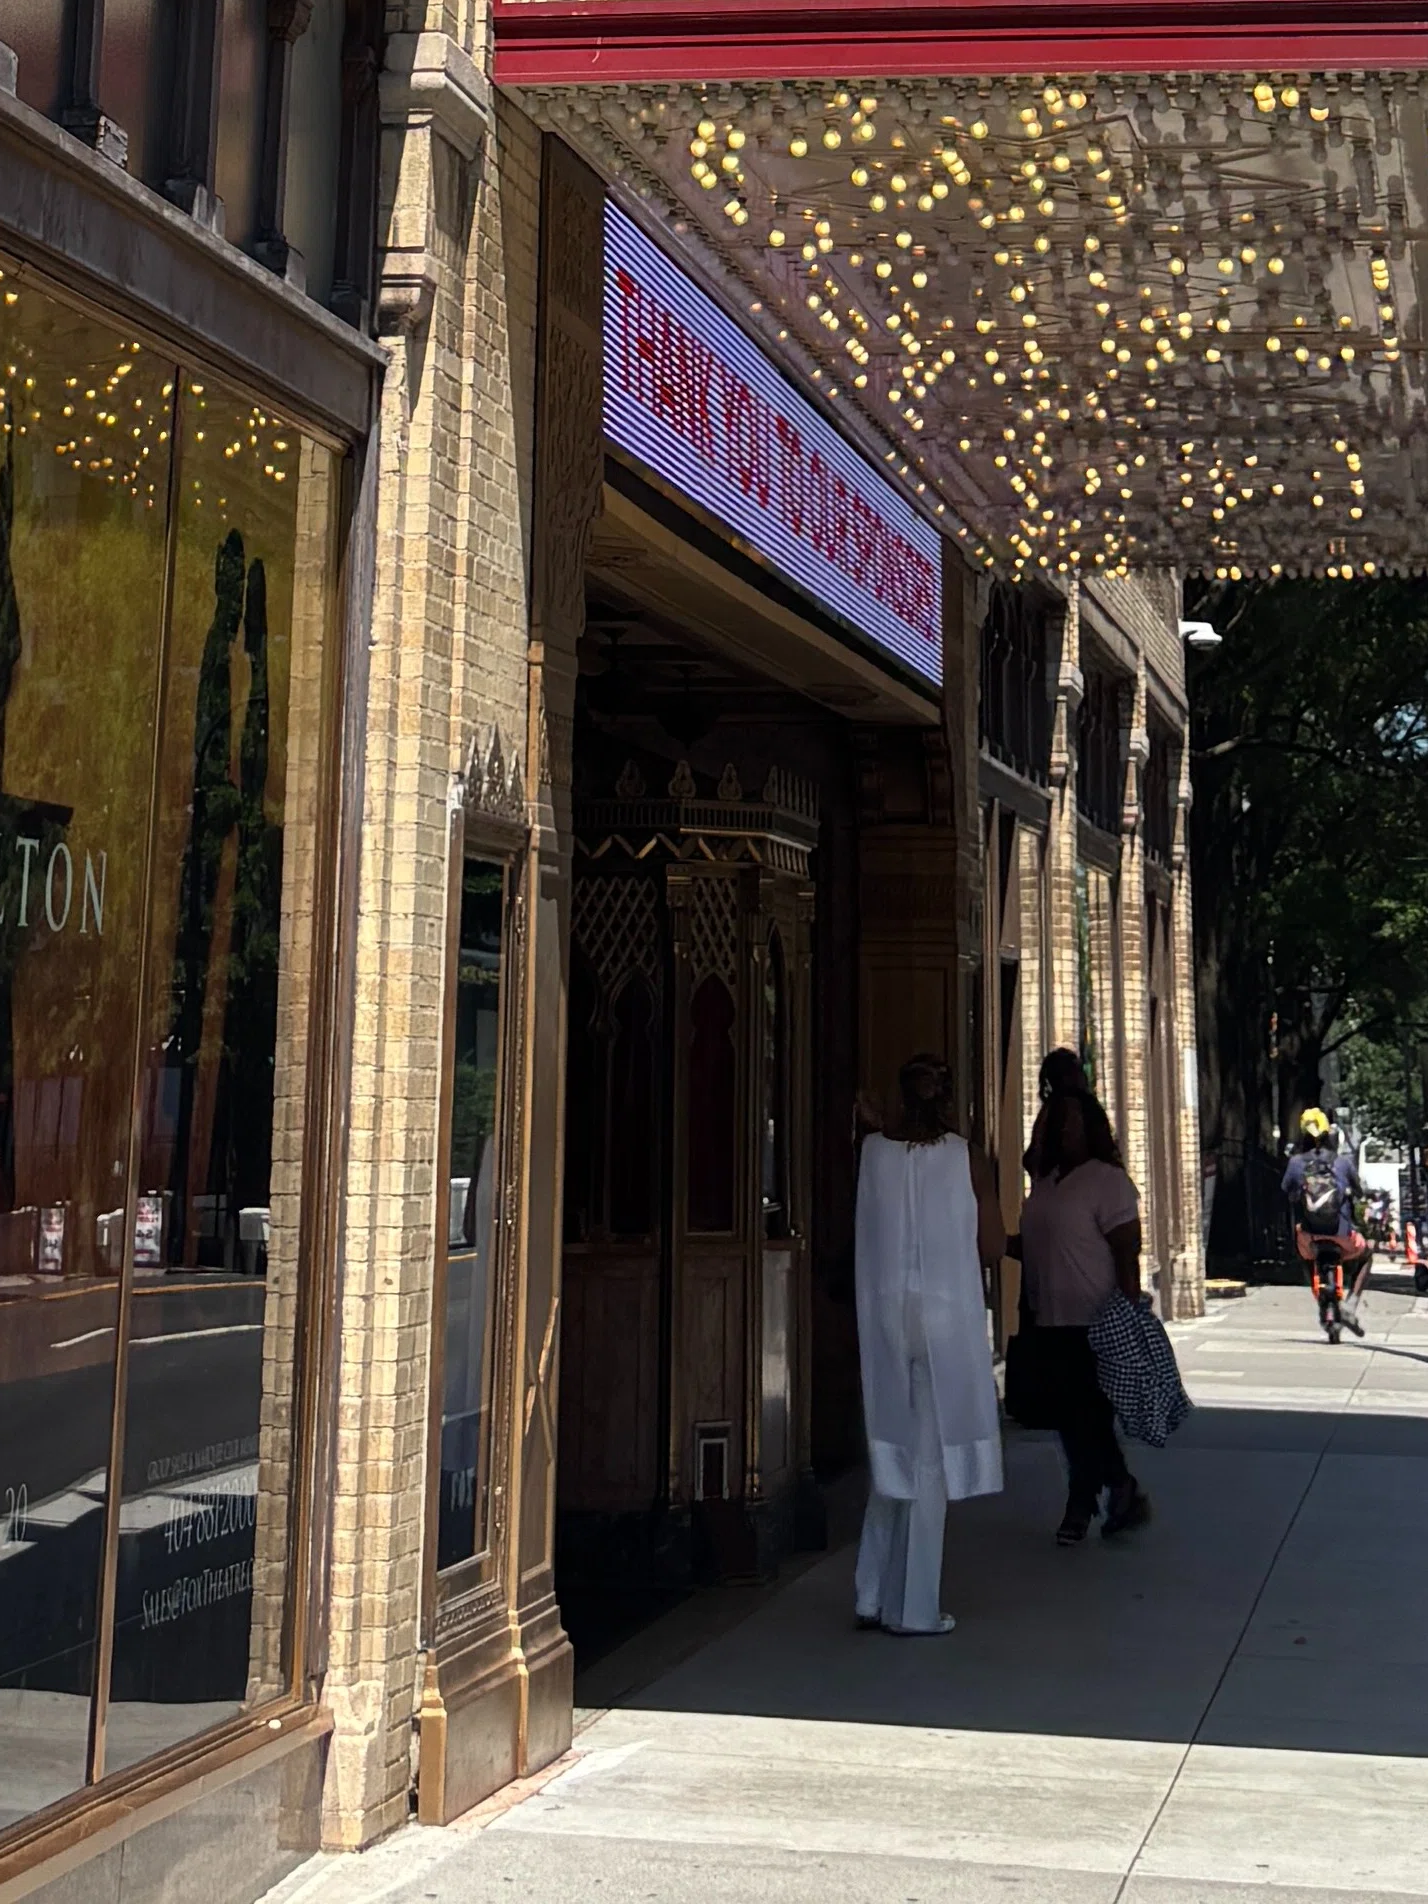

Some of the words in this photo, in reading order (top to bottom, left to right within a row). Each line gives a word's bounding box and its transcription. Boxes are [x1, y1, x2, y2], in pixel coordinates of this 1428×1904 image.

[615, 267, 712, 465] THANK
[720, 364, 770, 510] YOU
[776, 415, 805, 538] TO
